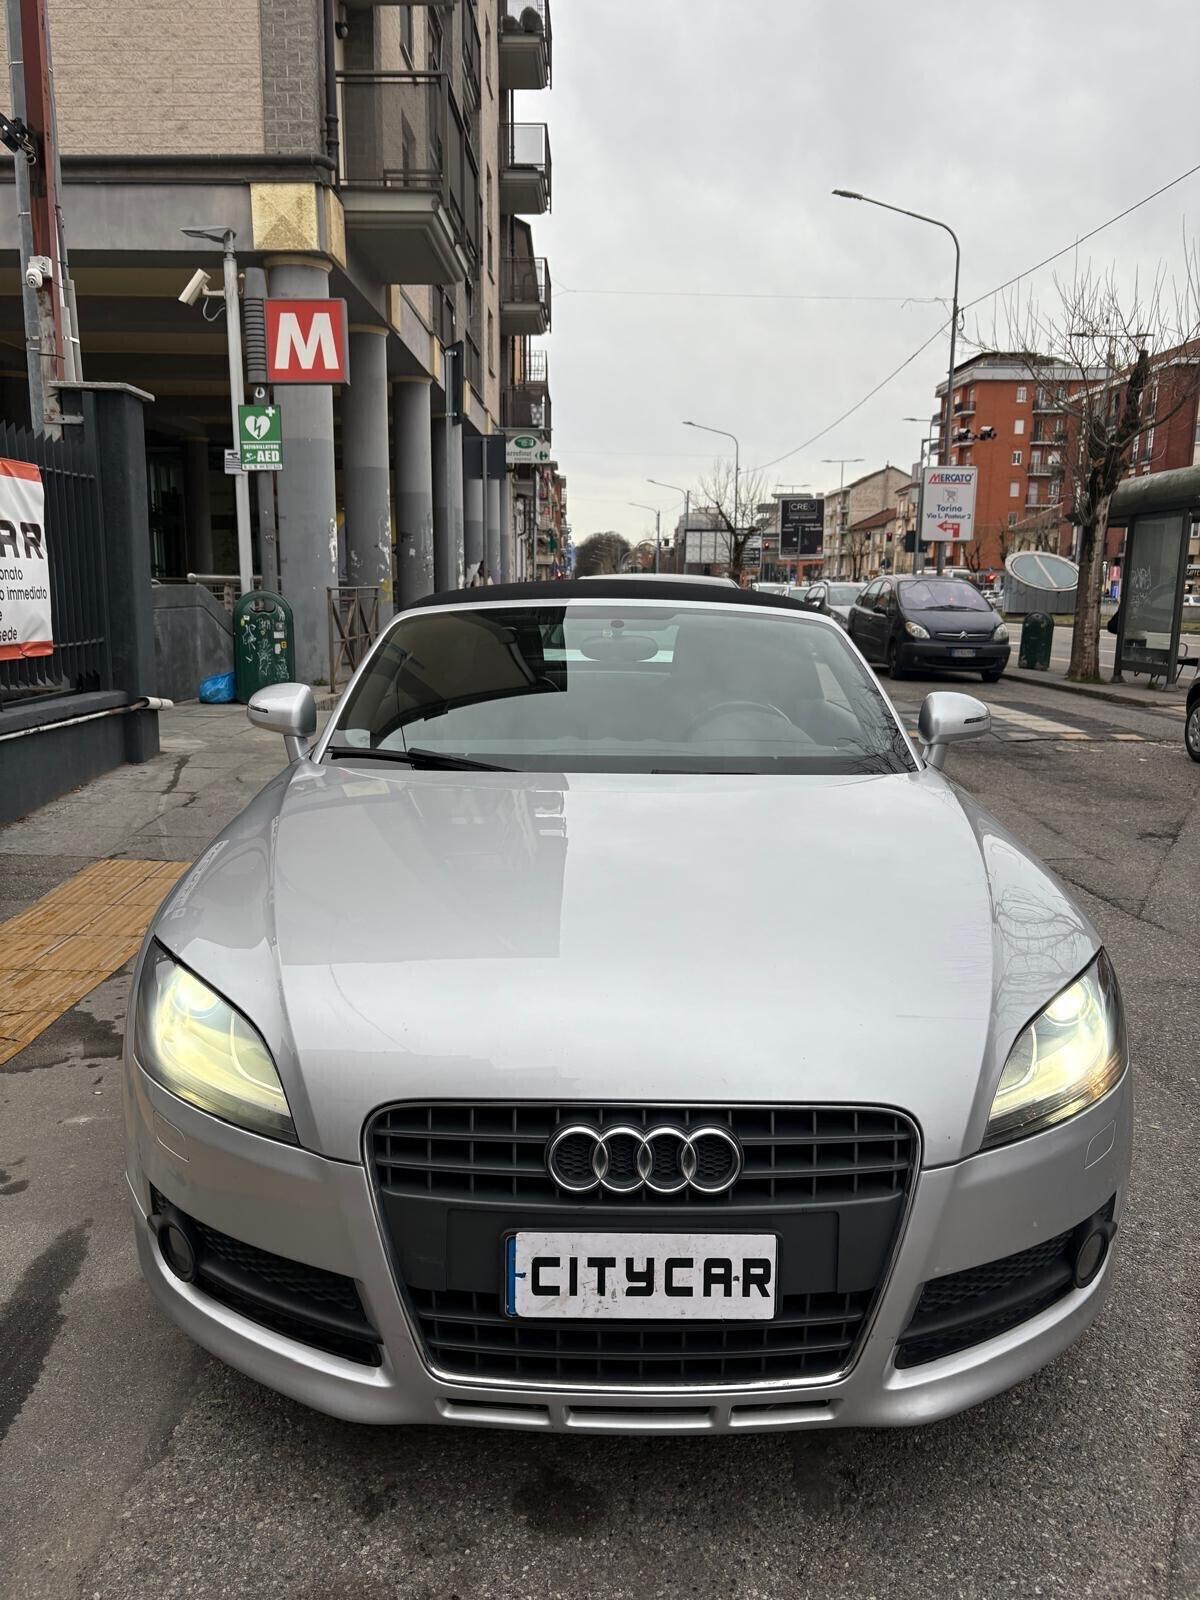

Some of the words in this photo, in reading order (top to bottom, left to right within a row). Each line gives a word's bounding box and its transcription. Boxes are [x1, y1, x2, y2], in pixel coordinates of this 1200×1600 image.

[275, 313, 339, 369] M
[257, 450, 280, 462] AED
[937, 504, 963, 512] Torino
[7, 585, 48, 600] immediato
[531, 1257, 772, 1298] CITYCAR
